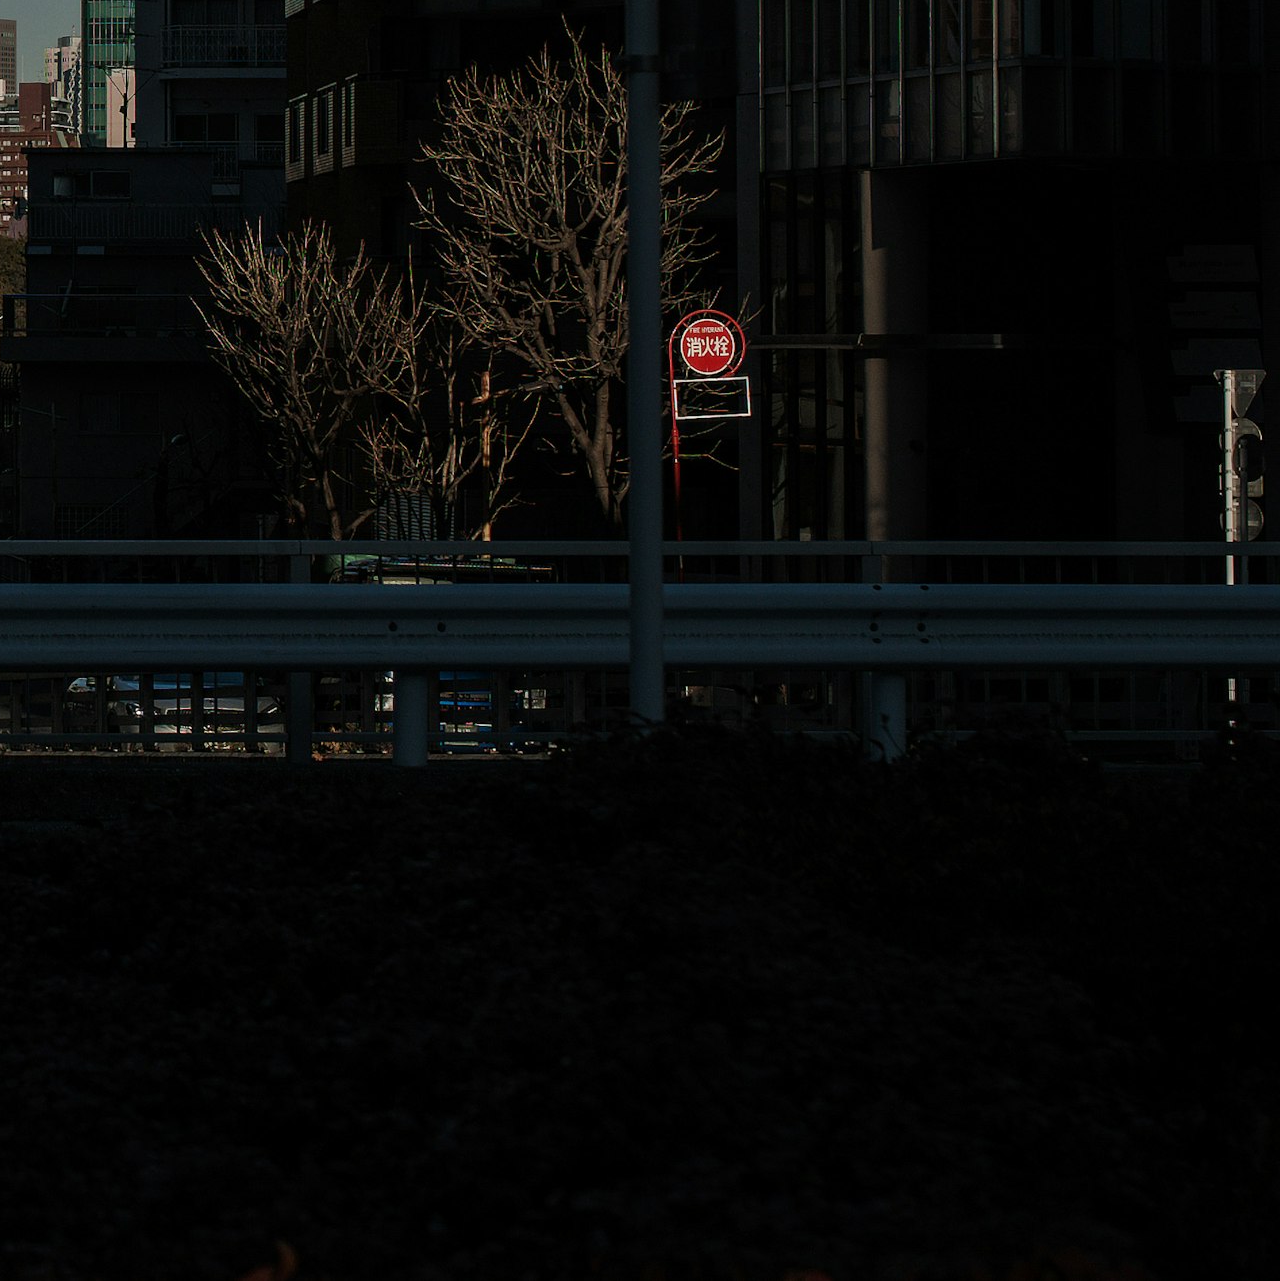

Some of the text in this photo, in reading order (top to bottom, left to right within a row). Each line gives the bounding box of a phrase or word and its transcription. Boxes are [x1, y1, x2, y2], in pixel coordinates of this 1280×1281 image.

[702, 326, 724, 334] HYDRANT
[686, 336, 730, 358] 消火栓
